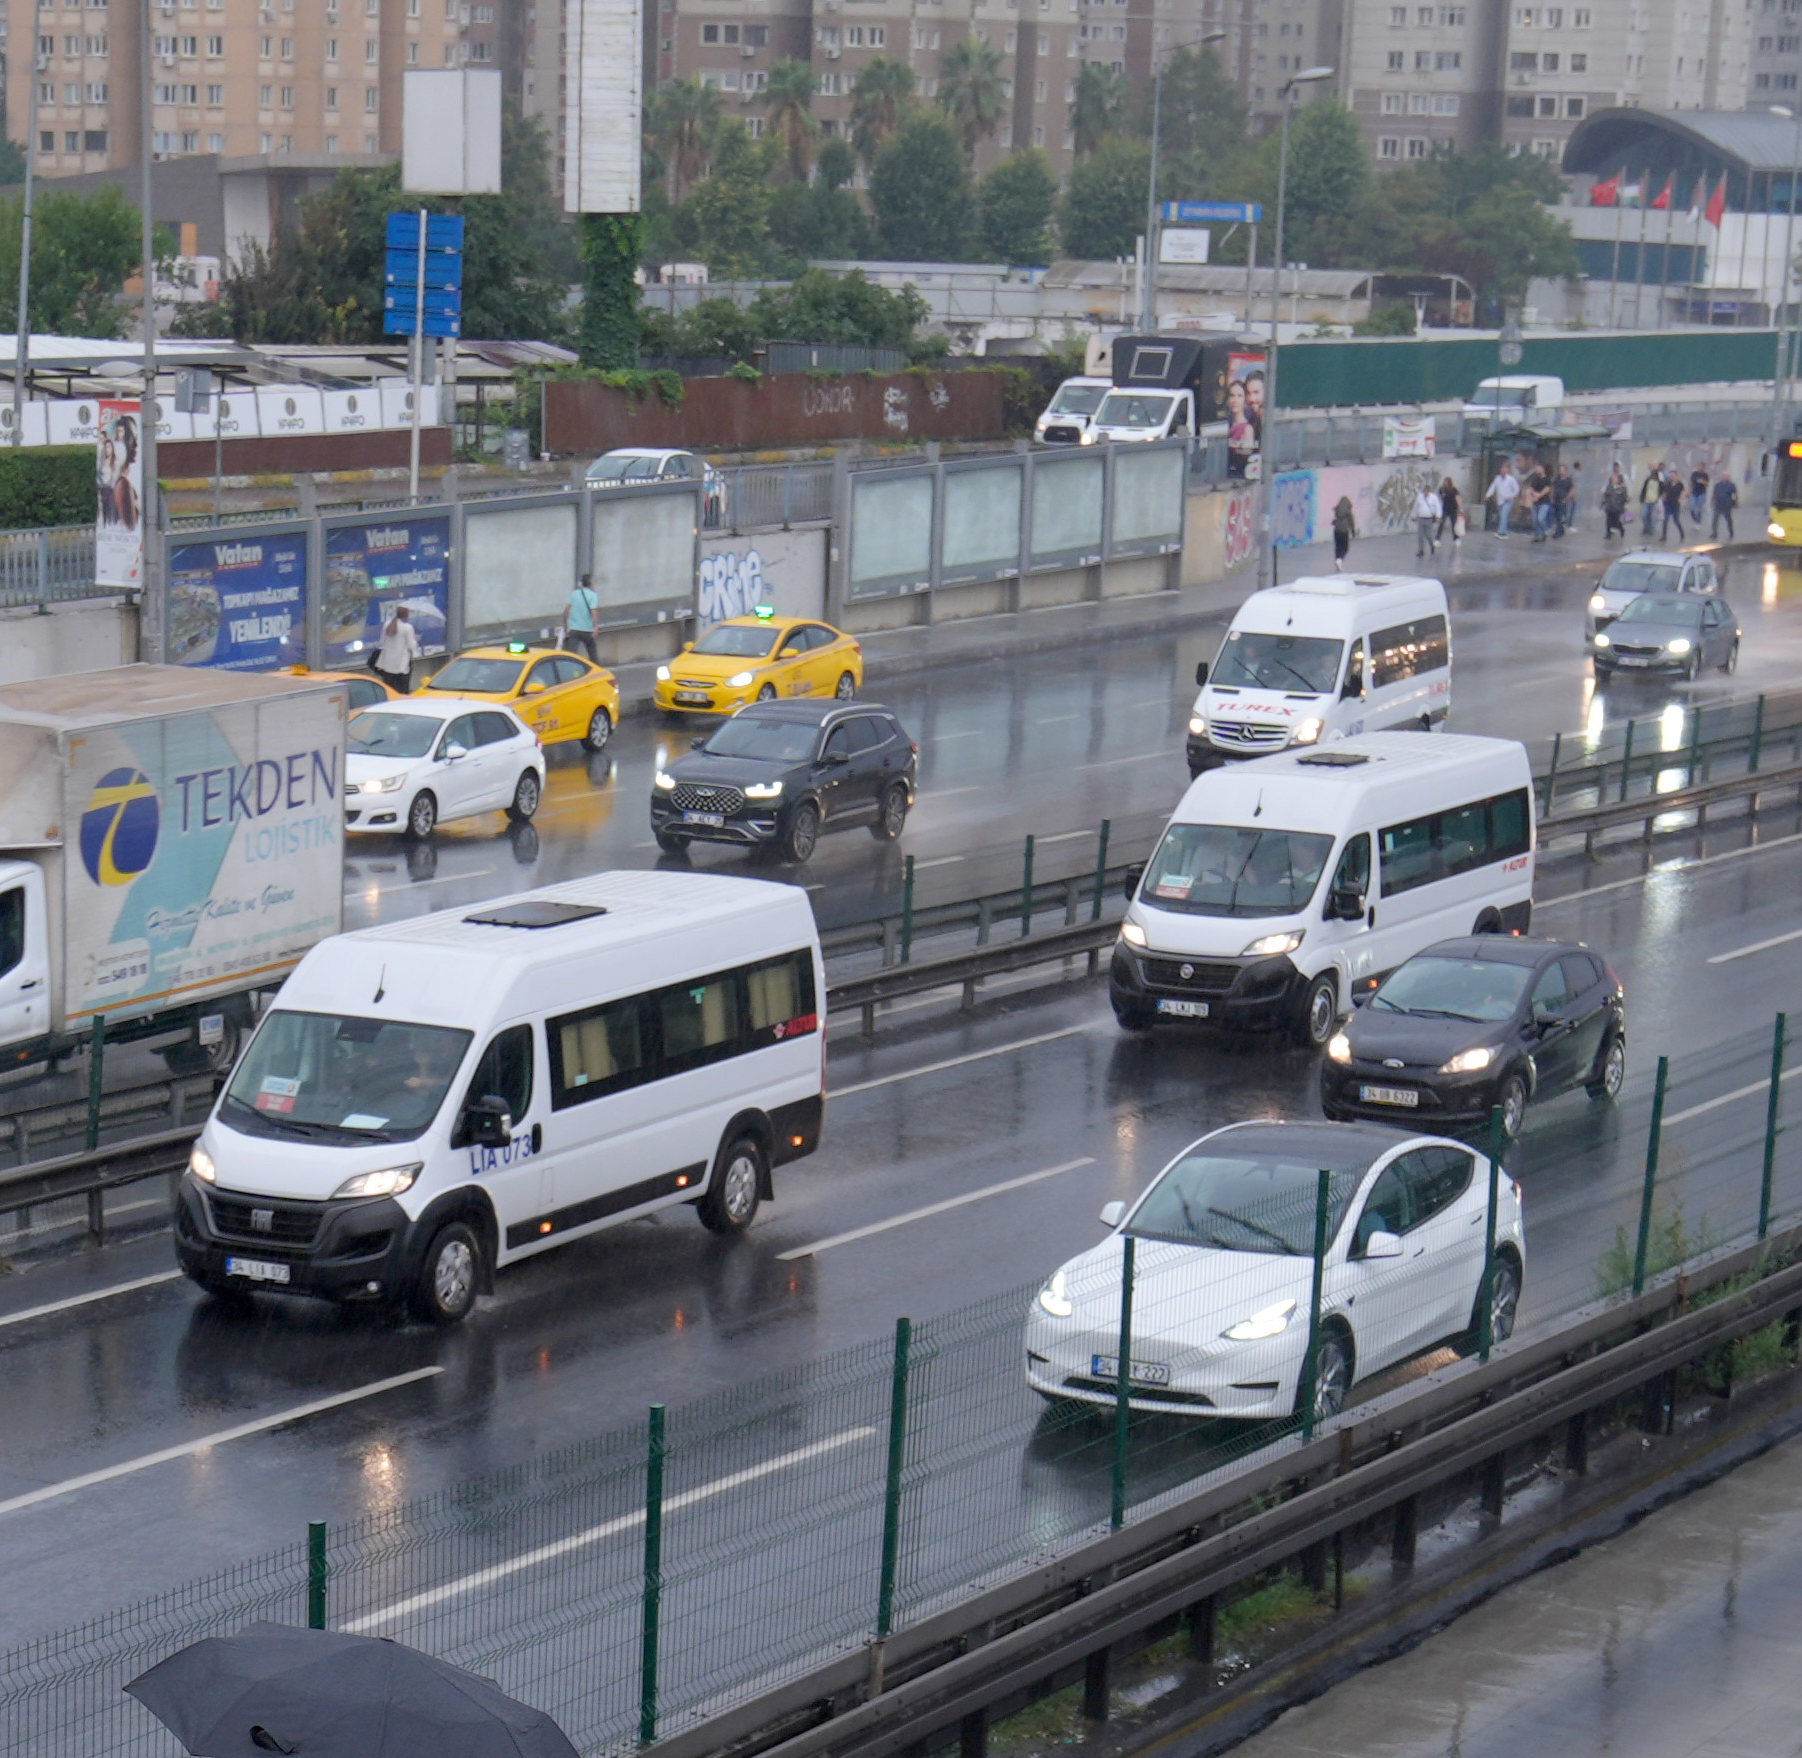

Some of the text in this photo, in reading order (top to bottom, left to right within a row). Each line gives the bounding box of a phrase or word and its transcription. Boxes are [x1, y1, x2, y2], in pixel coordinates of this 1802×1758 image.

[365, 528, 410, 549] Vatan
[215, 543, 263, 566] Vatan
[1217, 702, 1295, 717] TUREX
[175, 746, 338, 832] TEKDEN
[244, 810, 337, 864] LOJİSTİK
[1366, 1088, 1377, 1098] 34
[471, 1134, 533, 1176] LIA 073
